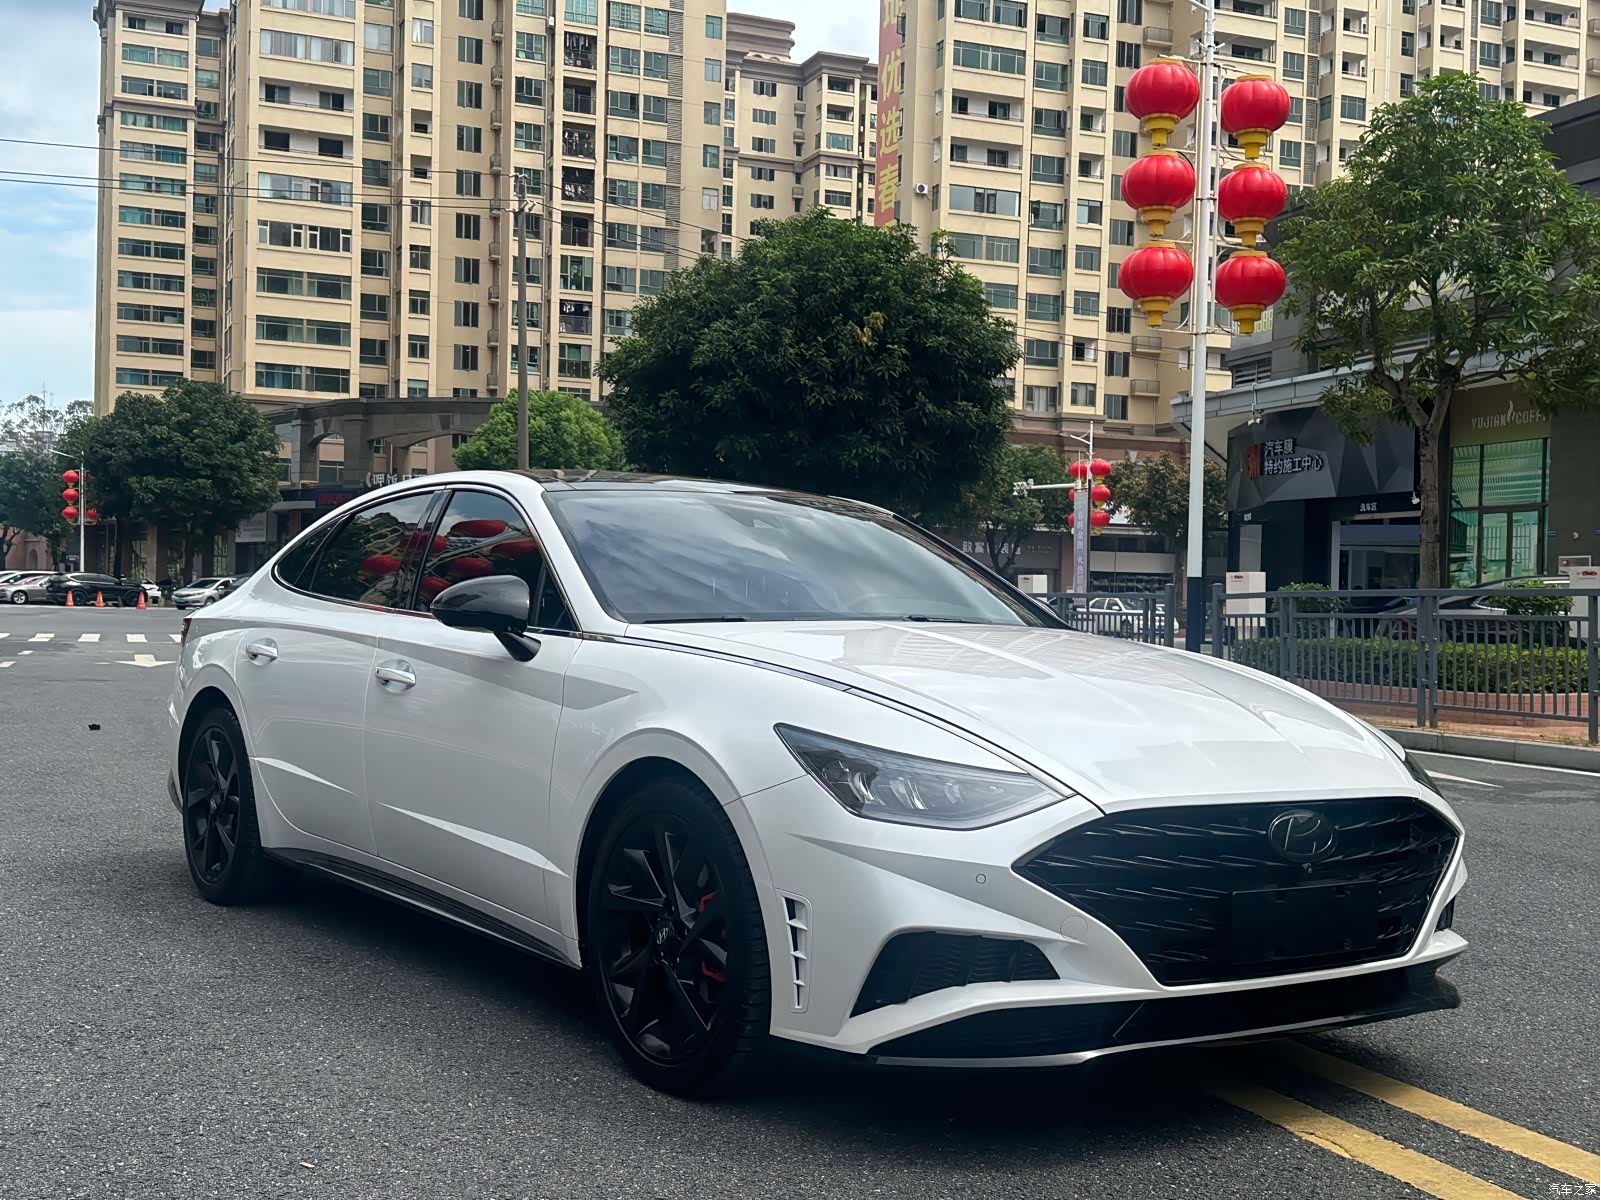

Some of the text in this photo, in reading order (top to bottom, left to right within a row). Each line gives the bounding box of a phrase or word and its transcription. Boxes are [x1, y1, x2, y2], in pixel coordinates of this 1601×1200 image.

[878, 0, 902, 231] 优选春
[1471, 413, 1506, 430] YUJIAN
[1264, 438, 1294, 457] 汽车膜
[1264, 455, 1323, 476] 特约施工中心
